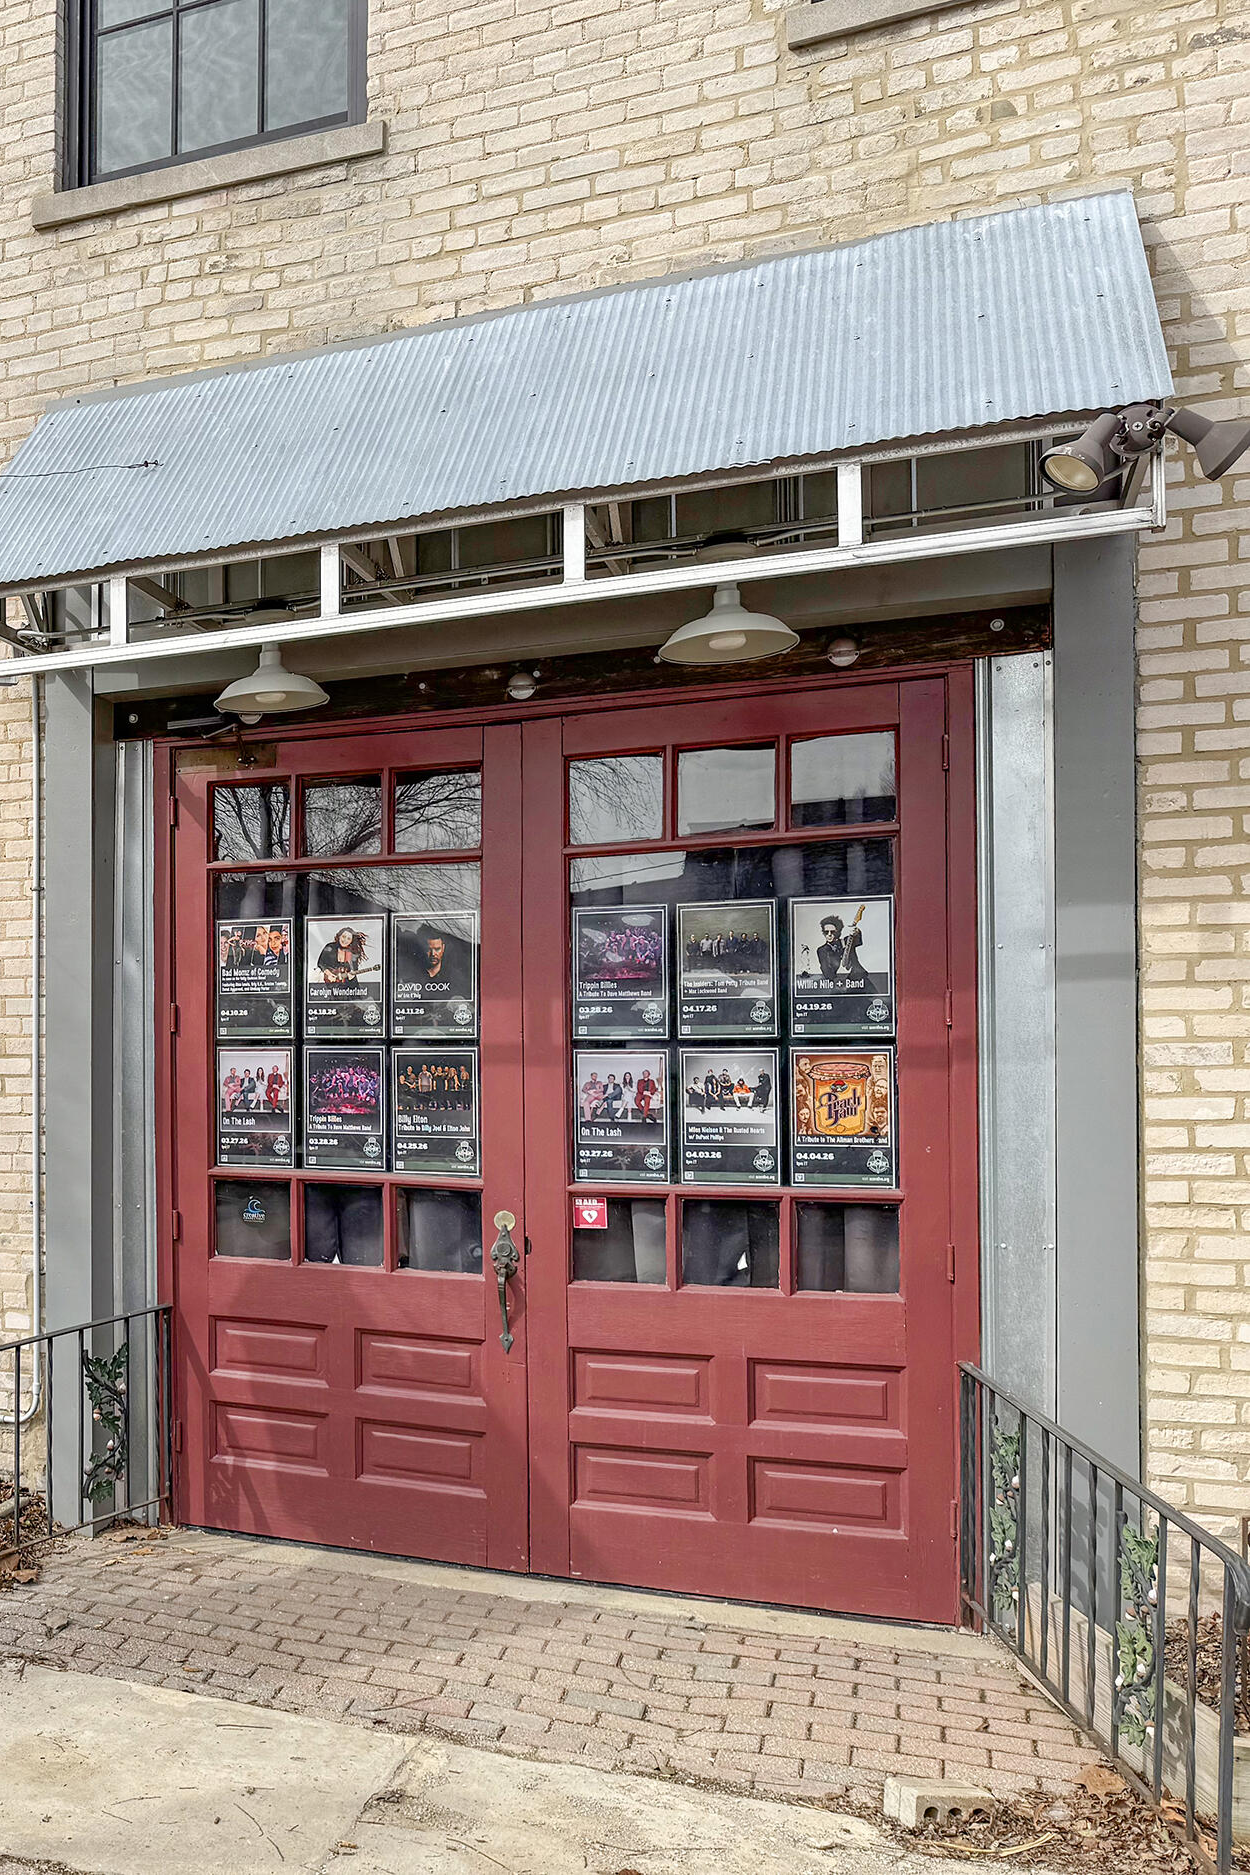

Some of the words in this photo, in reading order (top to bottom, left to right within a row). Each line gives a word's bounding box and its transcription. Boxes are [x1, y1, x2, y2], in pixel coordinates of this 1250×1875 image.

[251, 968, 256, 976] of
[258, 968, 280, 977] Comedy
[398, 983, 422, 991] DAVID
[425, 983, 450, 991] COOK
[579, 982, 599, 990] Trippin
[797, 980, 817, 989] Willie
[820, 980, 833, 989] Nile
[845, 979, 864, 988] Band
[310, 988, 331, 998] Carolyn
[333, 988, 367, 996] Wonderland
[819, 1088, 861, 1120] Peach
[231, 1117, 241, 1125] The
[243, 1117, 255, 1125] Lash
[310, 1115, 327, 1123] Trippin
[398, 1114, 411, 1125] Billy
[413, 1115, 428, 1123] Elton
[827, 1107, 857, 1128] Jam
[581, 1127, 590, 1136] On
[592, 1127, 604, 1136] The
[606, 1128, 622, 1136] Lash
